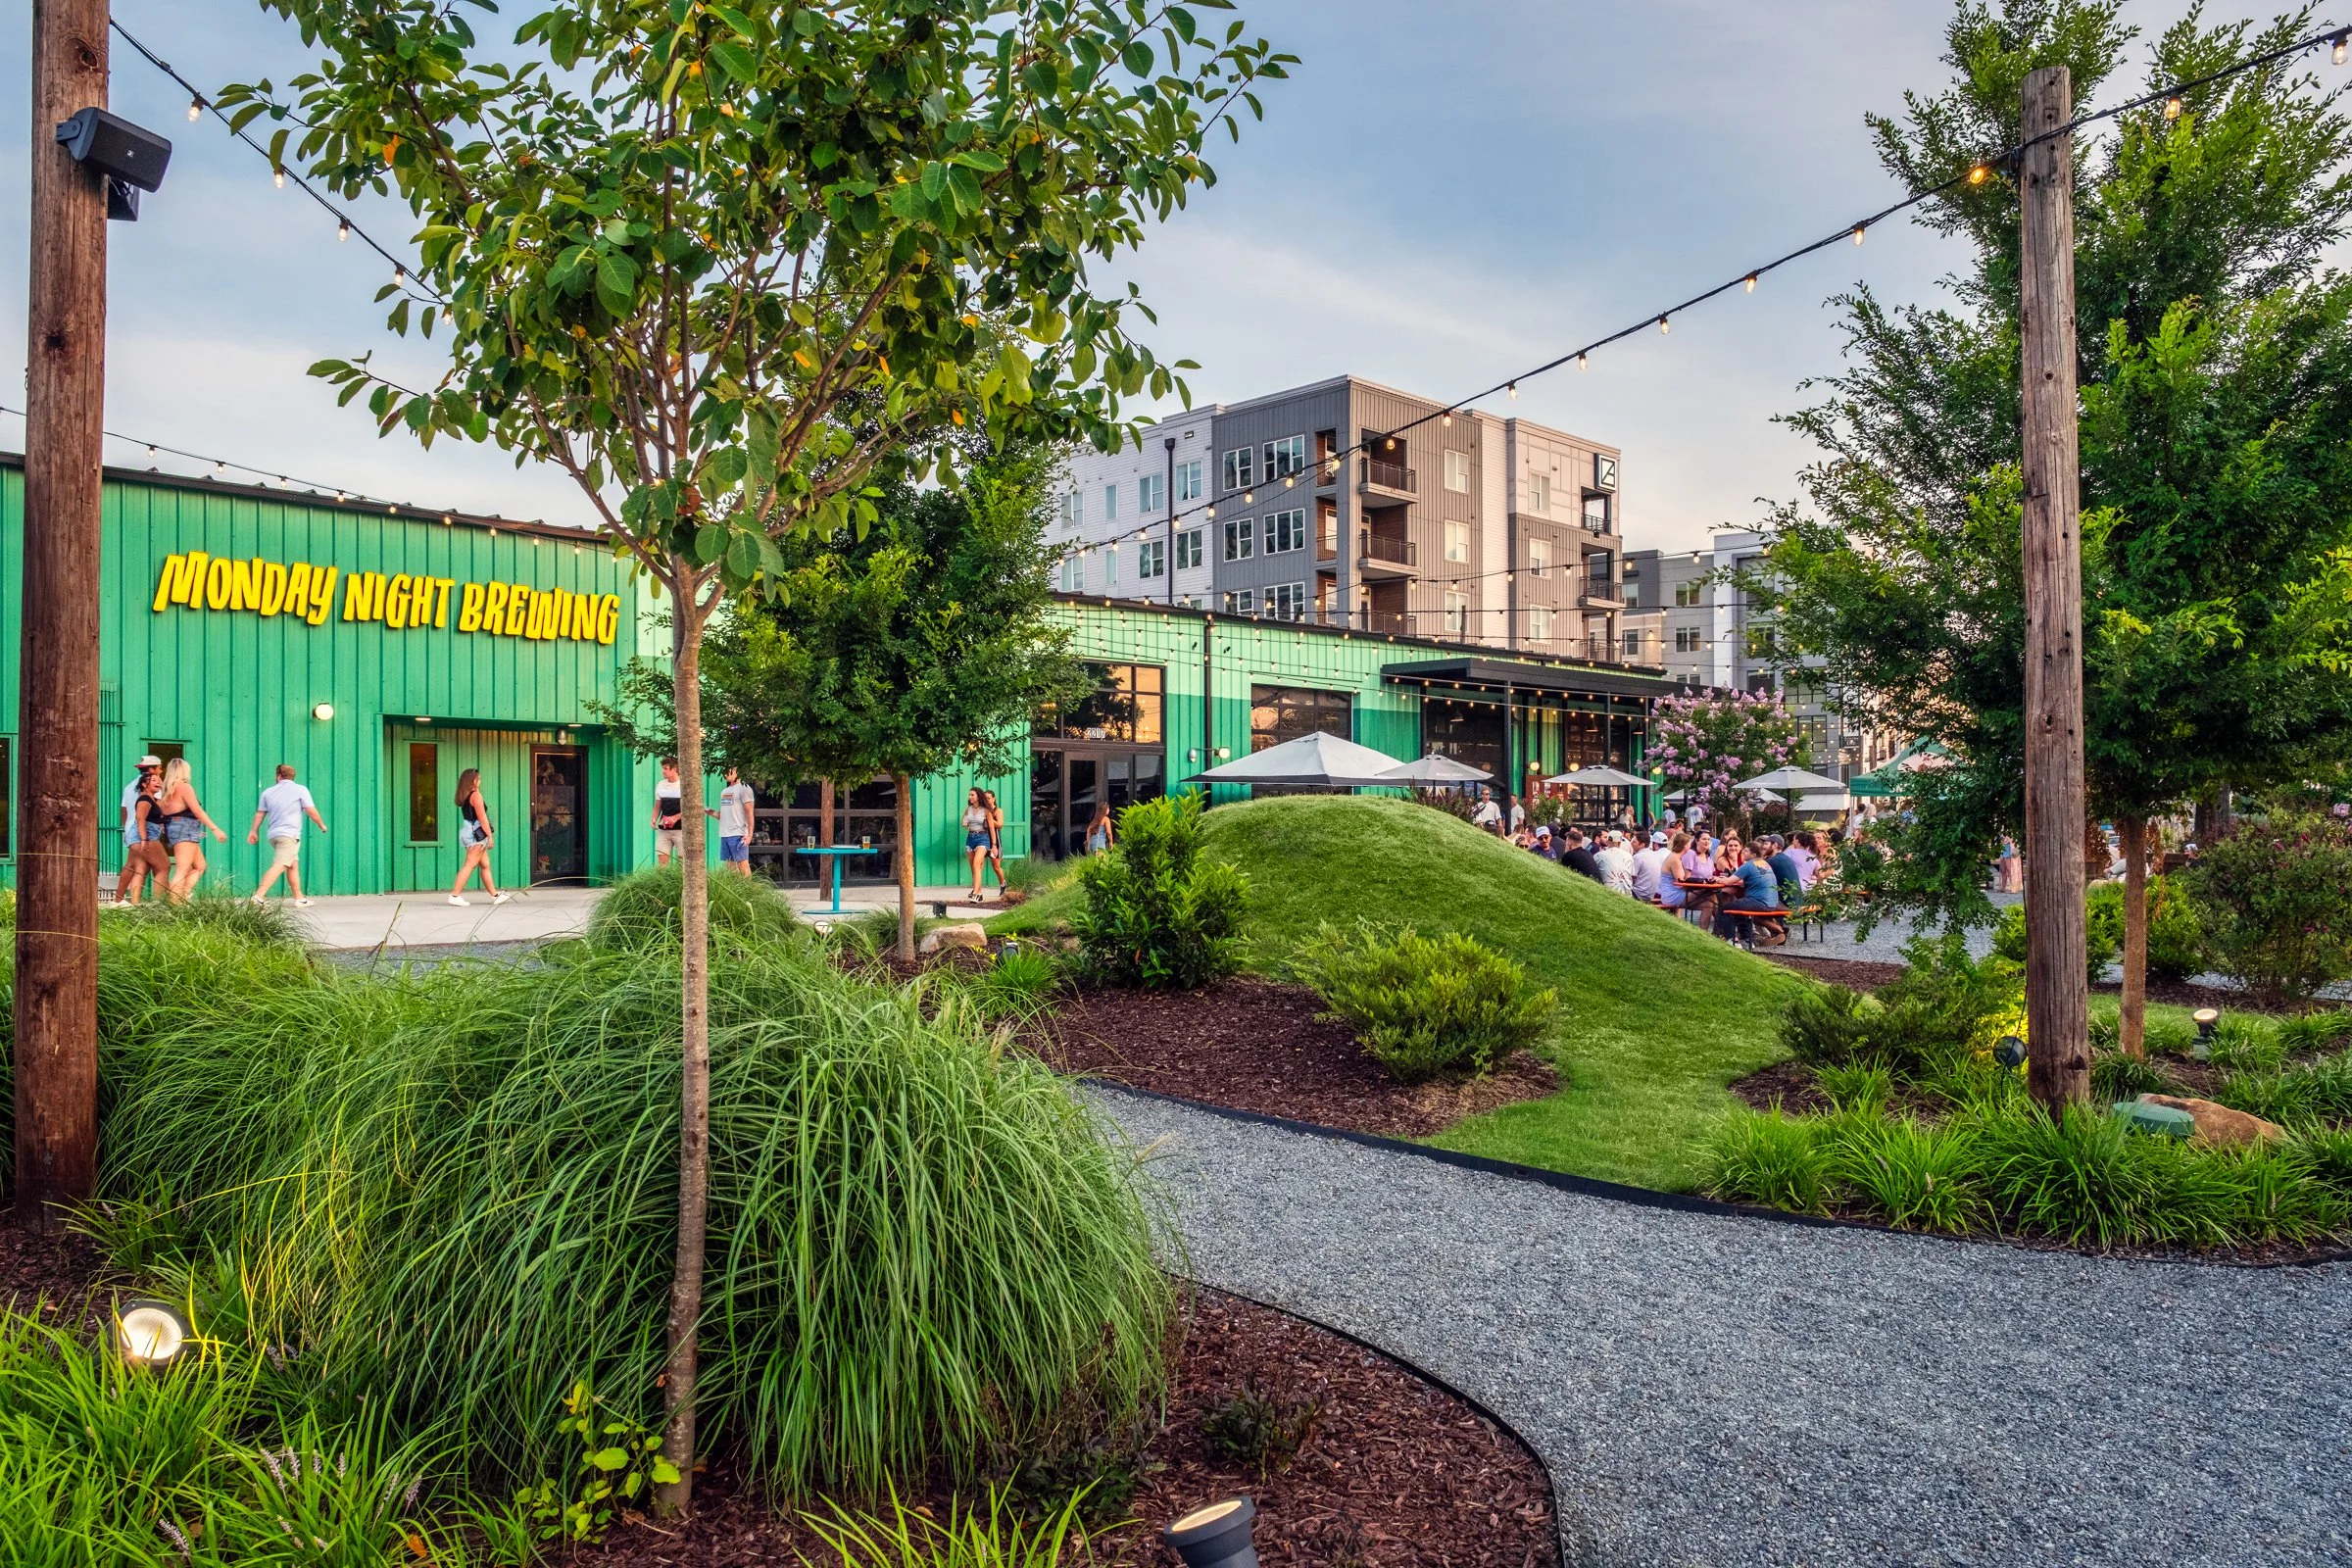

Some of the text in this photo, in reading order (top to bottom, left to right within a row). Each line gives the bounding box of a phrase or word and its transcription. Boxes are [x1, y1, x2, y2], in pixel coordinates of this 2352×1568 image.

[153, 551, 619, 645] MONDAY NIGHT BREWING
